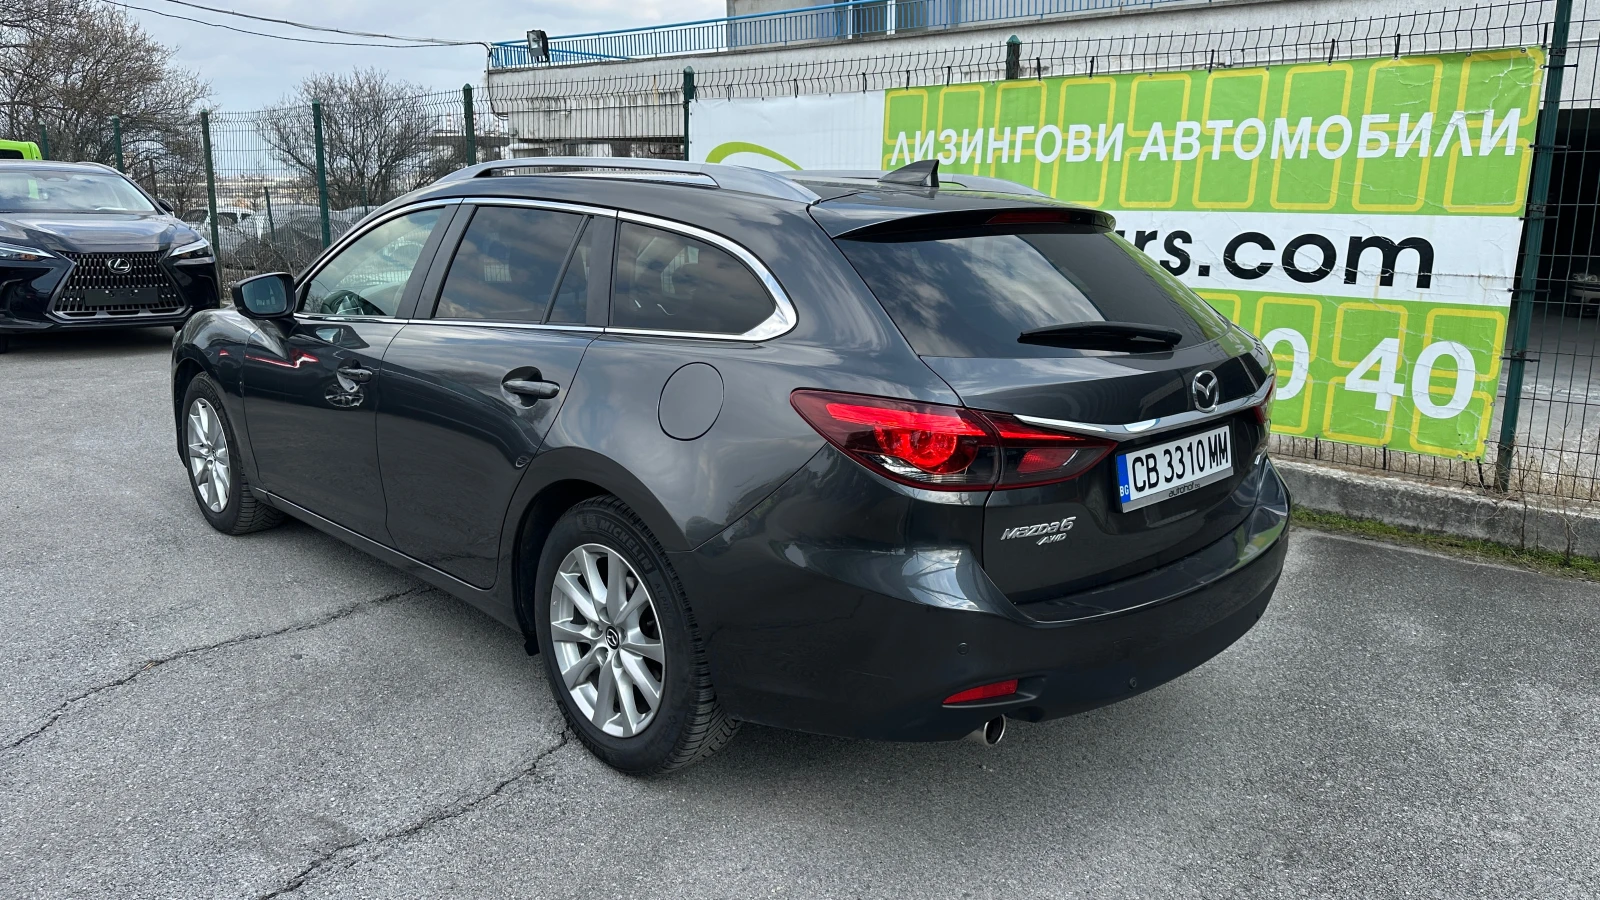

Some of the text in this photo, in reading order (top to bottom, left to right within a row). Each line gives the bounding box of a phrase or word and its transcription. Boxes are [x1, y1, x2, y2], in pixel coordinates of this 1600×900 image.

[890, 107, 1521, 166] ЛИЗИНГОВИ АВТОМОБИЛИ
[1115, 229, 1434, 289] rs.com
[1345, 338, 1476, 419] 40
[1120, 484, 1130, 497] BG
[1132, 431, 1229, 493] CB 3310 MM
[598, 519, 654, 571] MICHELIN
[1036, 532, 1068, 546] AWD
